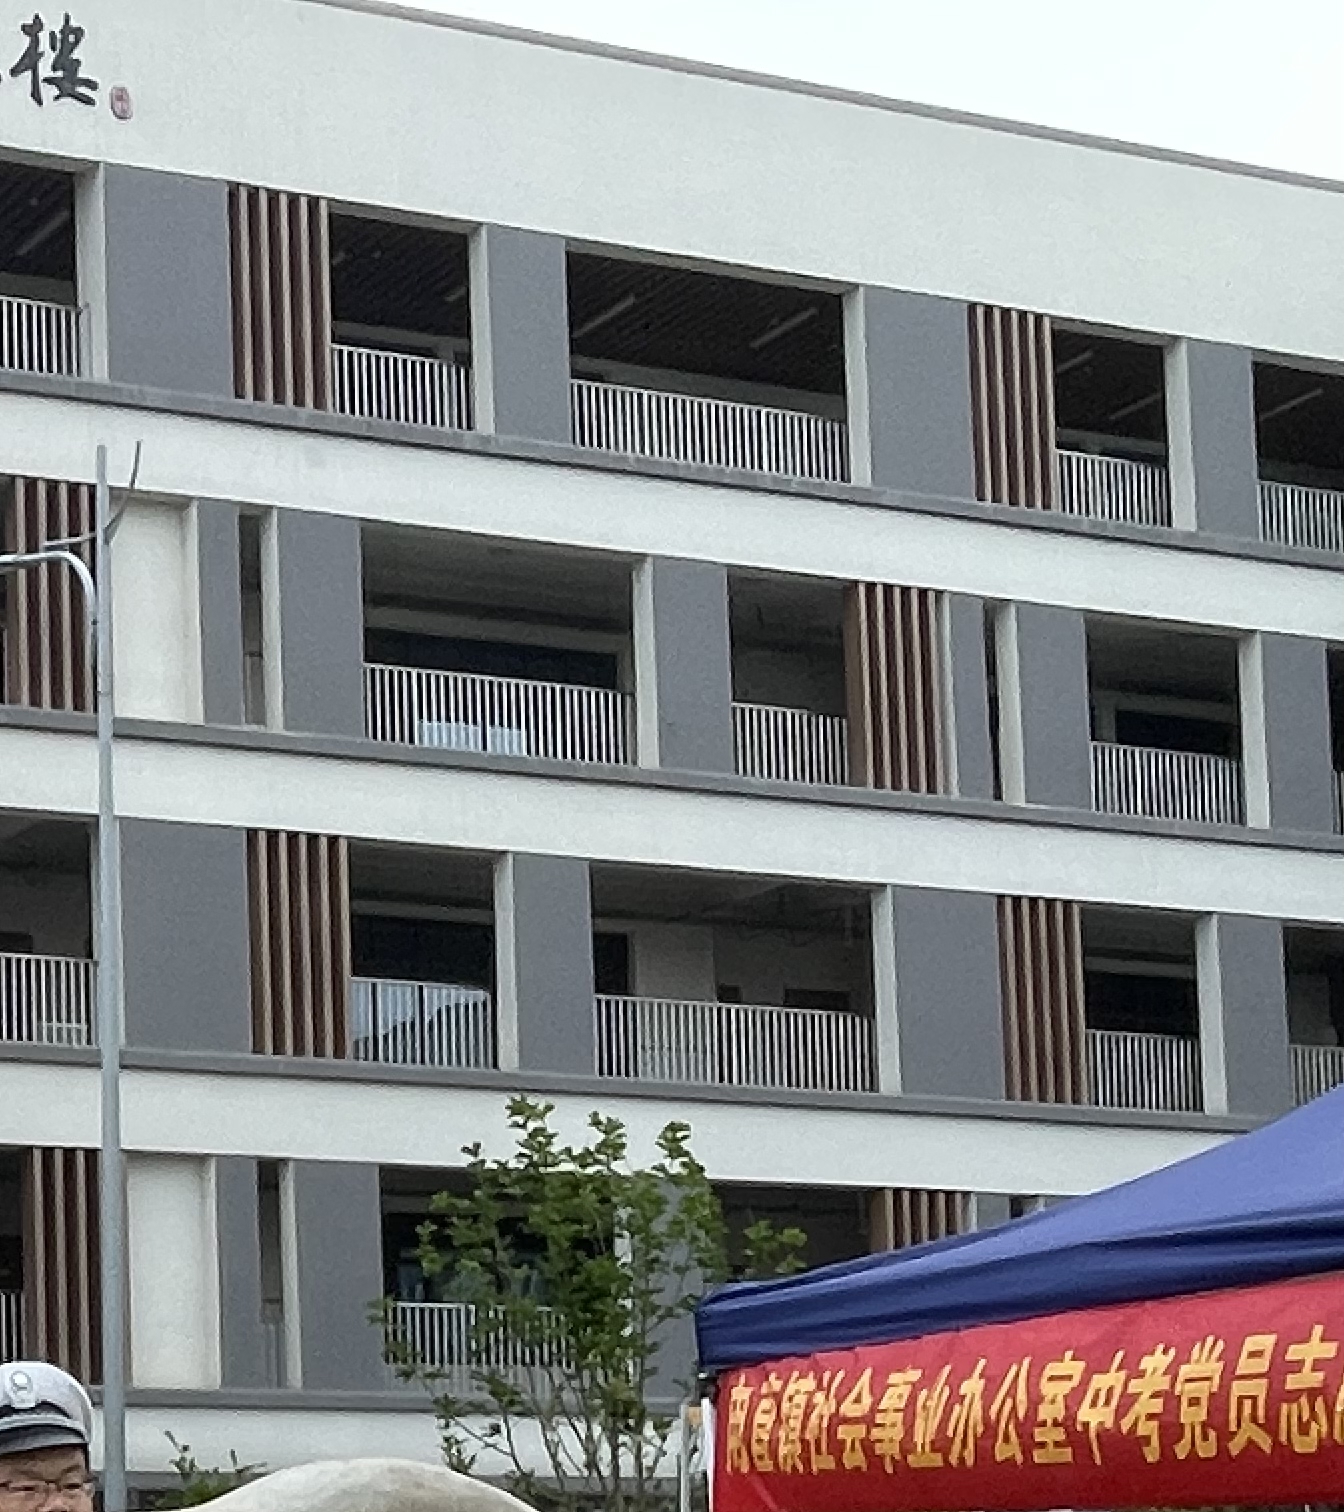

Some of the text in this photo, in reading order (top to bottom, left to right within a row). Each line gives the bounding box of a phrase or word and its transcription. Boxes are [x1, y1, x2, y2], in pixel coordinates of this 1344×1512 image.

[724, 1324, 1344, 1476] 甪直镇社会事业办公室中考党员志
